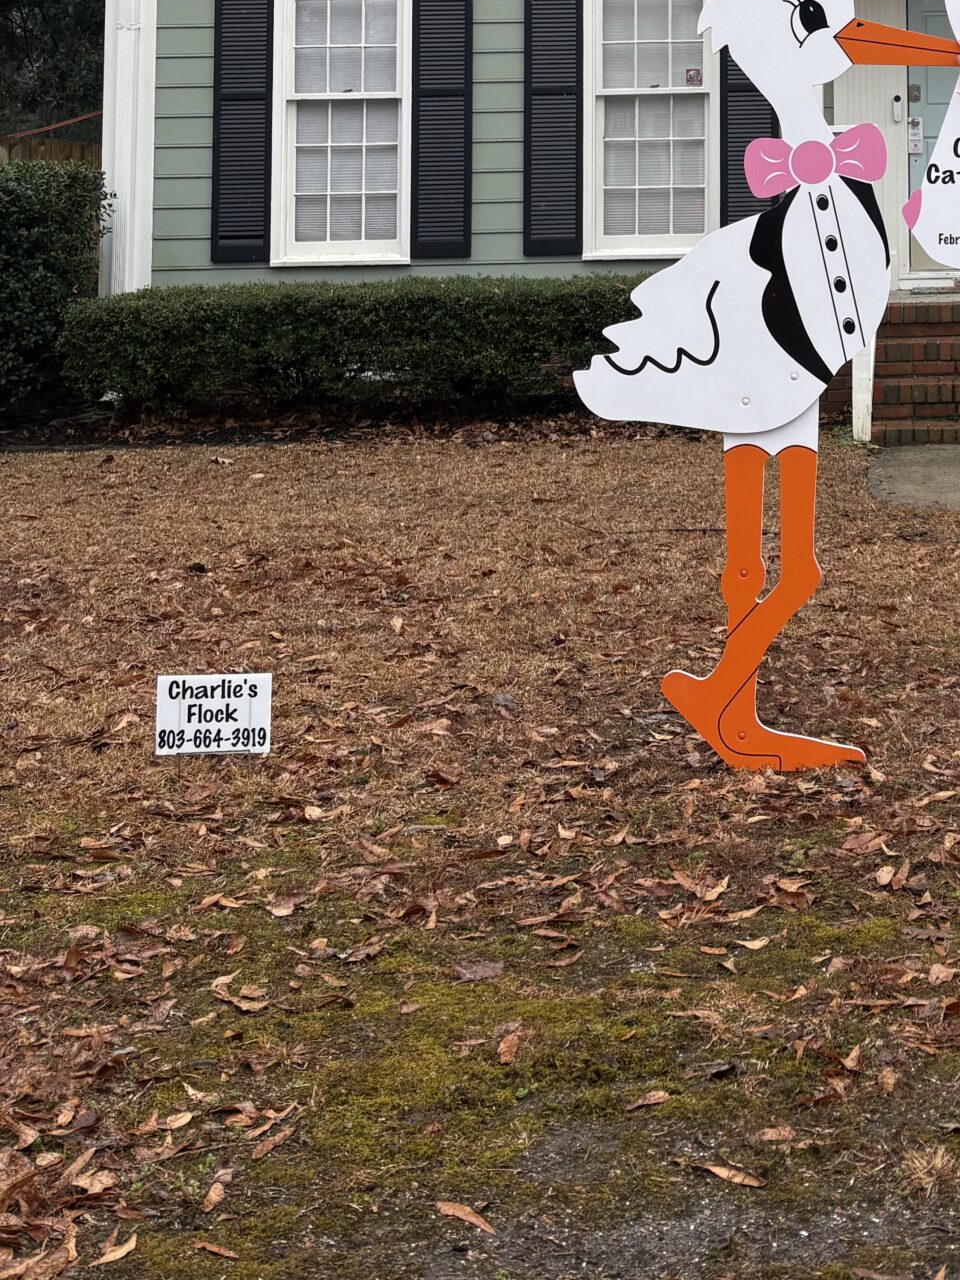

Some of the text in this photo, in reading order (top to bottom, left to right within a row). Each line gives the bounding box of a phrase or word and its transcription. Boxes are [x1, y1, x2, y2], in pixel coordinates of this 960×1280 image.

[168, 678, 258, 700] Charlie's
[187, 703, 238, 724] Flock
[158, 727, 267, 750] 803-664-3919
